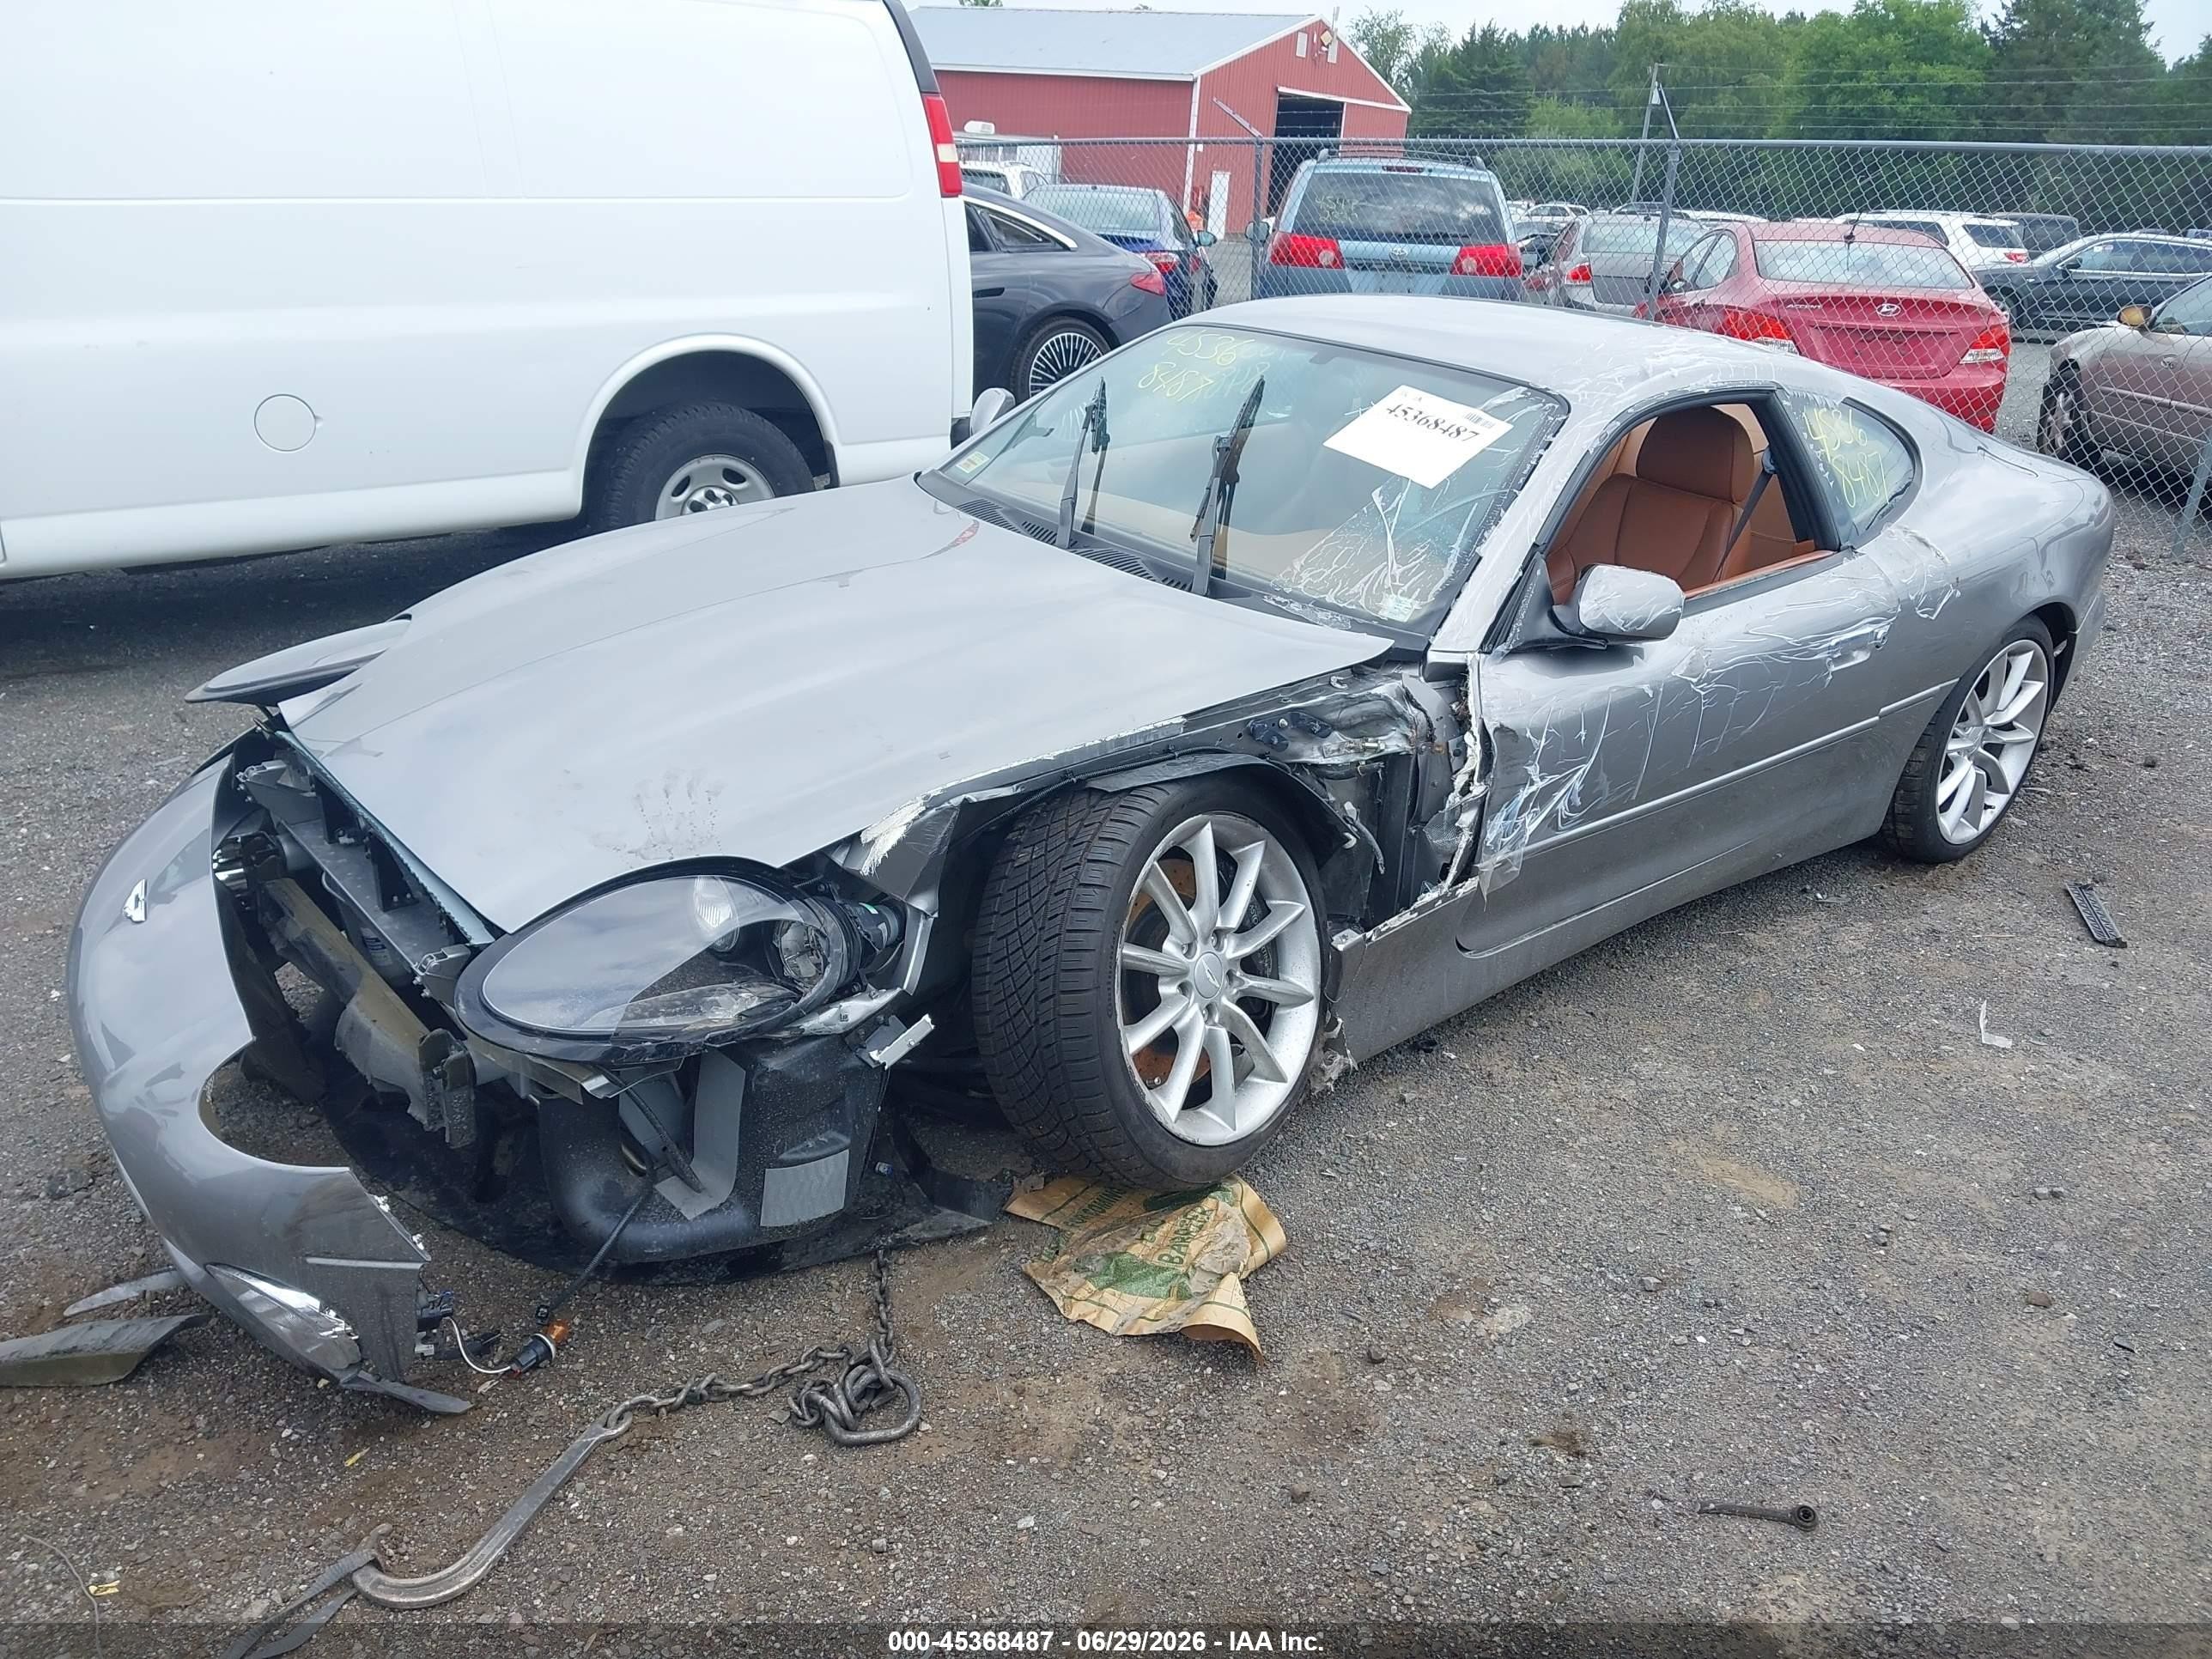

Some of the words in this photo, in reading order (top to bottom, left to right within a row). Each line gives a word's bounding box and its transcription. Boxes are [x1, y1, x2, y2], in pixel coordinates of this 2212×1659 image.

[1161, 330, 1255, 366] 4536
[1138, 362, 1215, 402] 8487
[1386, 404, 1480, 441] 45368487
[1802, 408, 1868, 464] 4536
[1832, 452, 1890, 508] 8487
